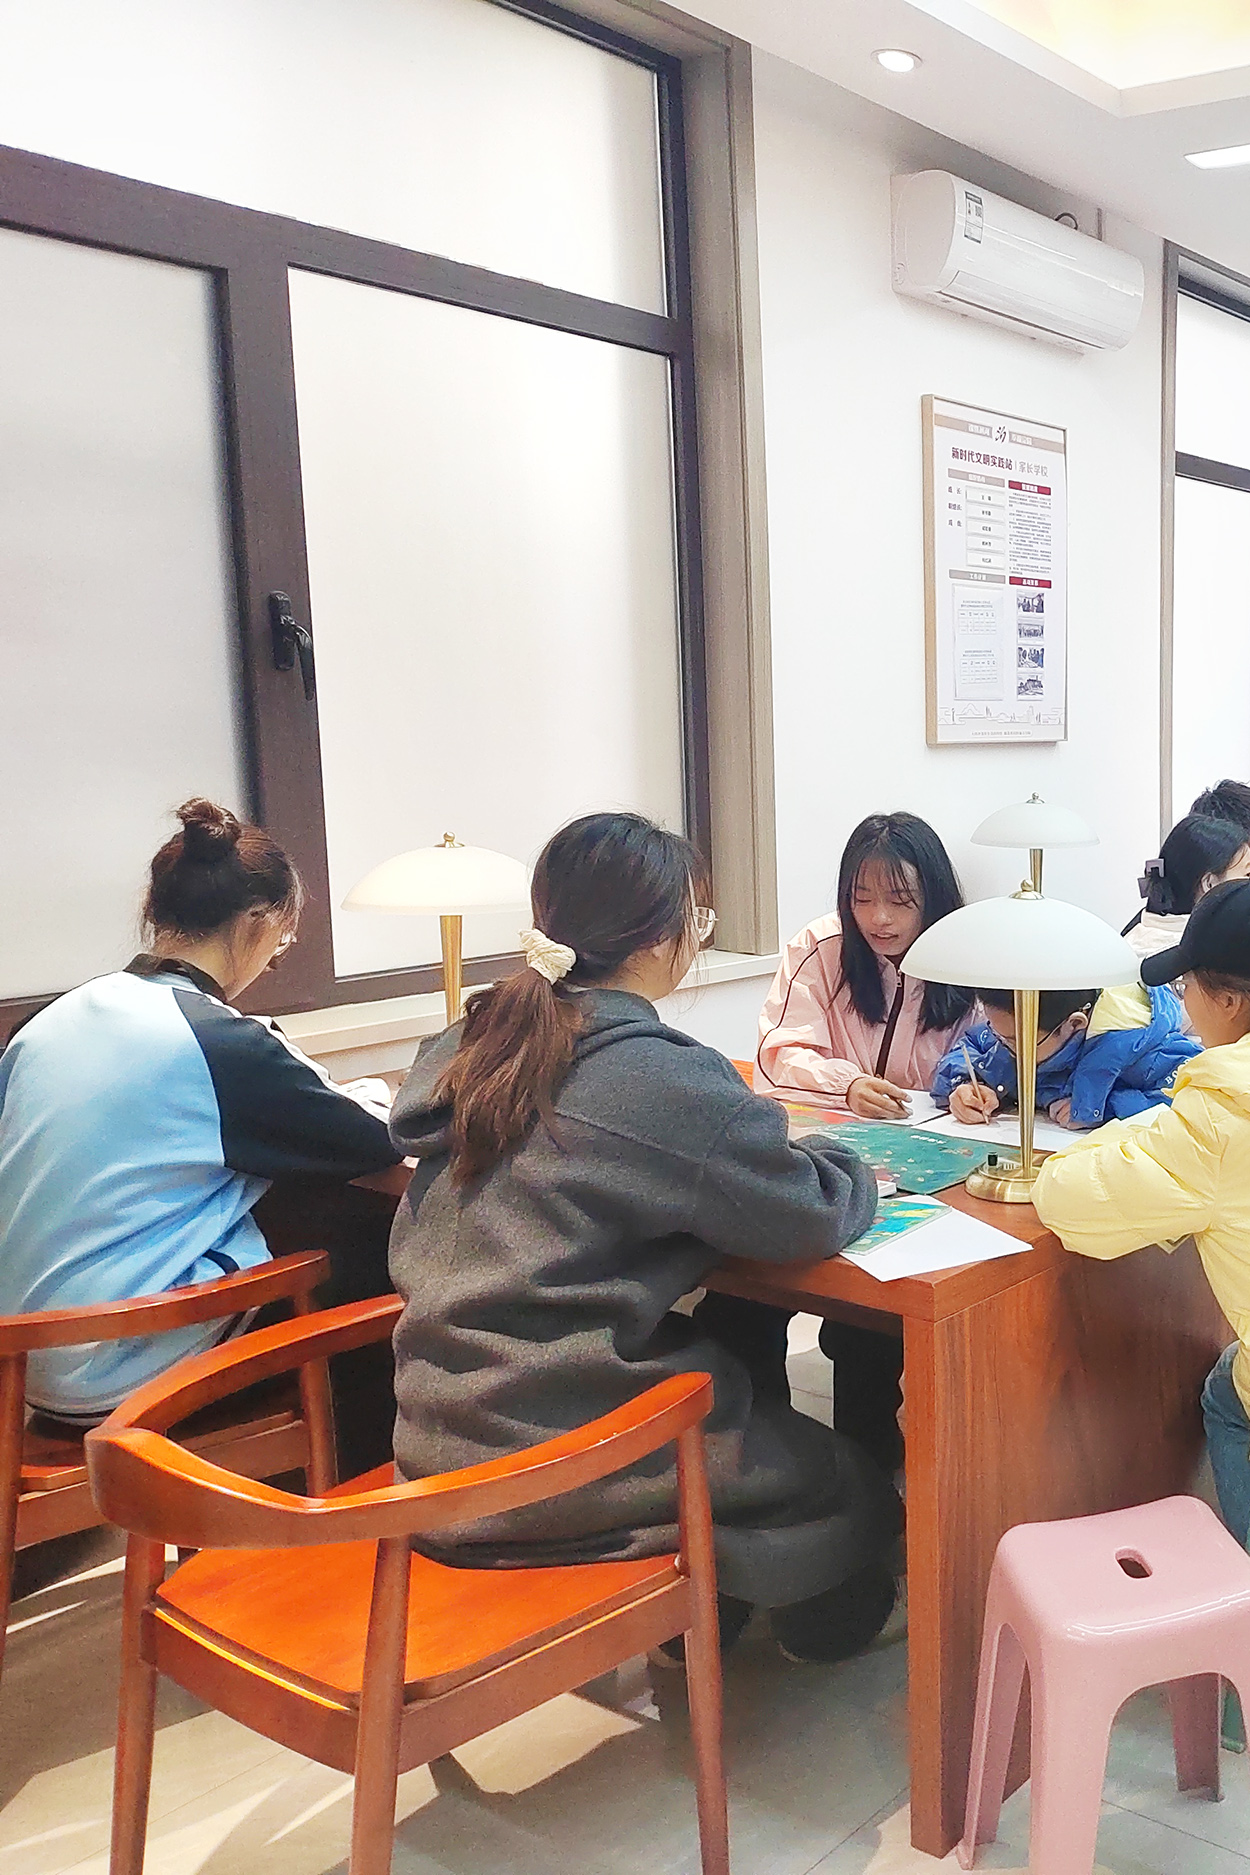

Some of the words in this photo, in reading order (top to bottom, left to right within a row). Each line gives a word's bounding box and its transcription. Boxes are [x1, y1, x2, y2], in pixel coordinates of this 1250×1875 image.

[951, 446, 1013, 471] 新时代文明实践站
[1018, 460, 1049, 478] 家长学校
